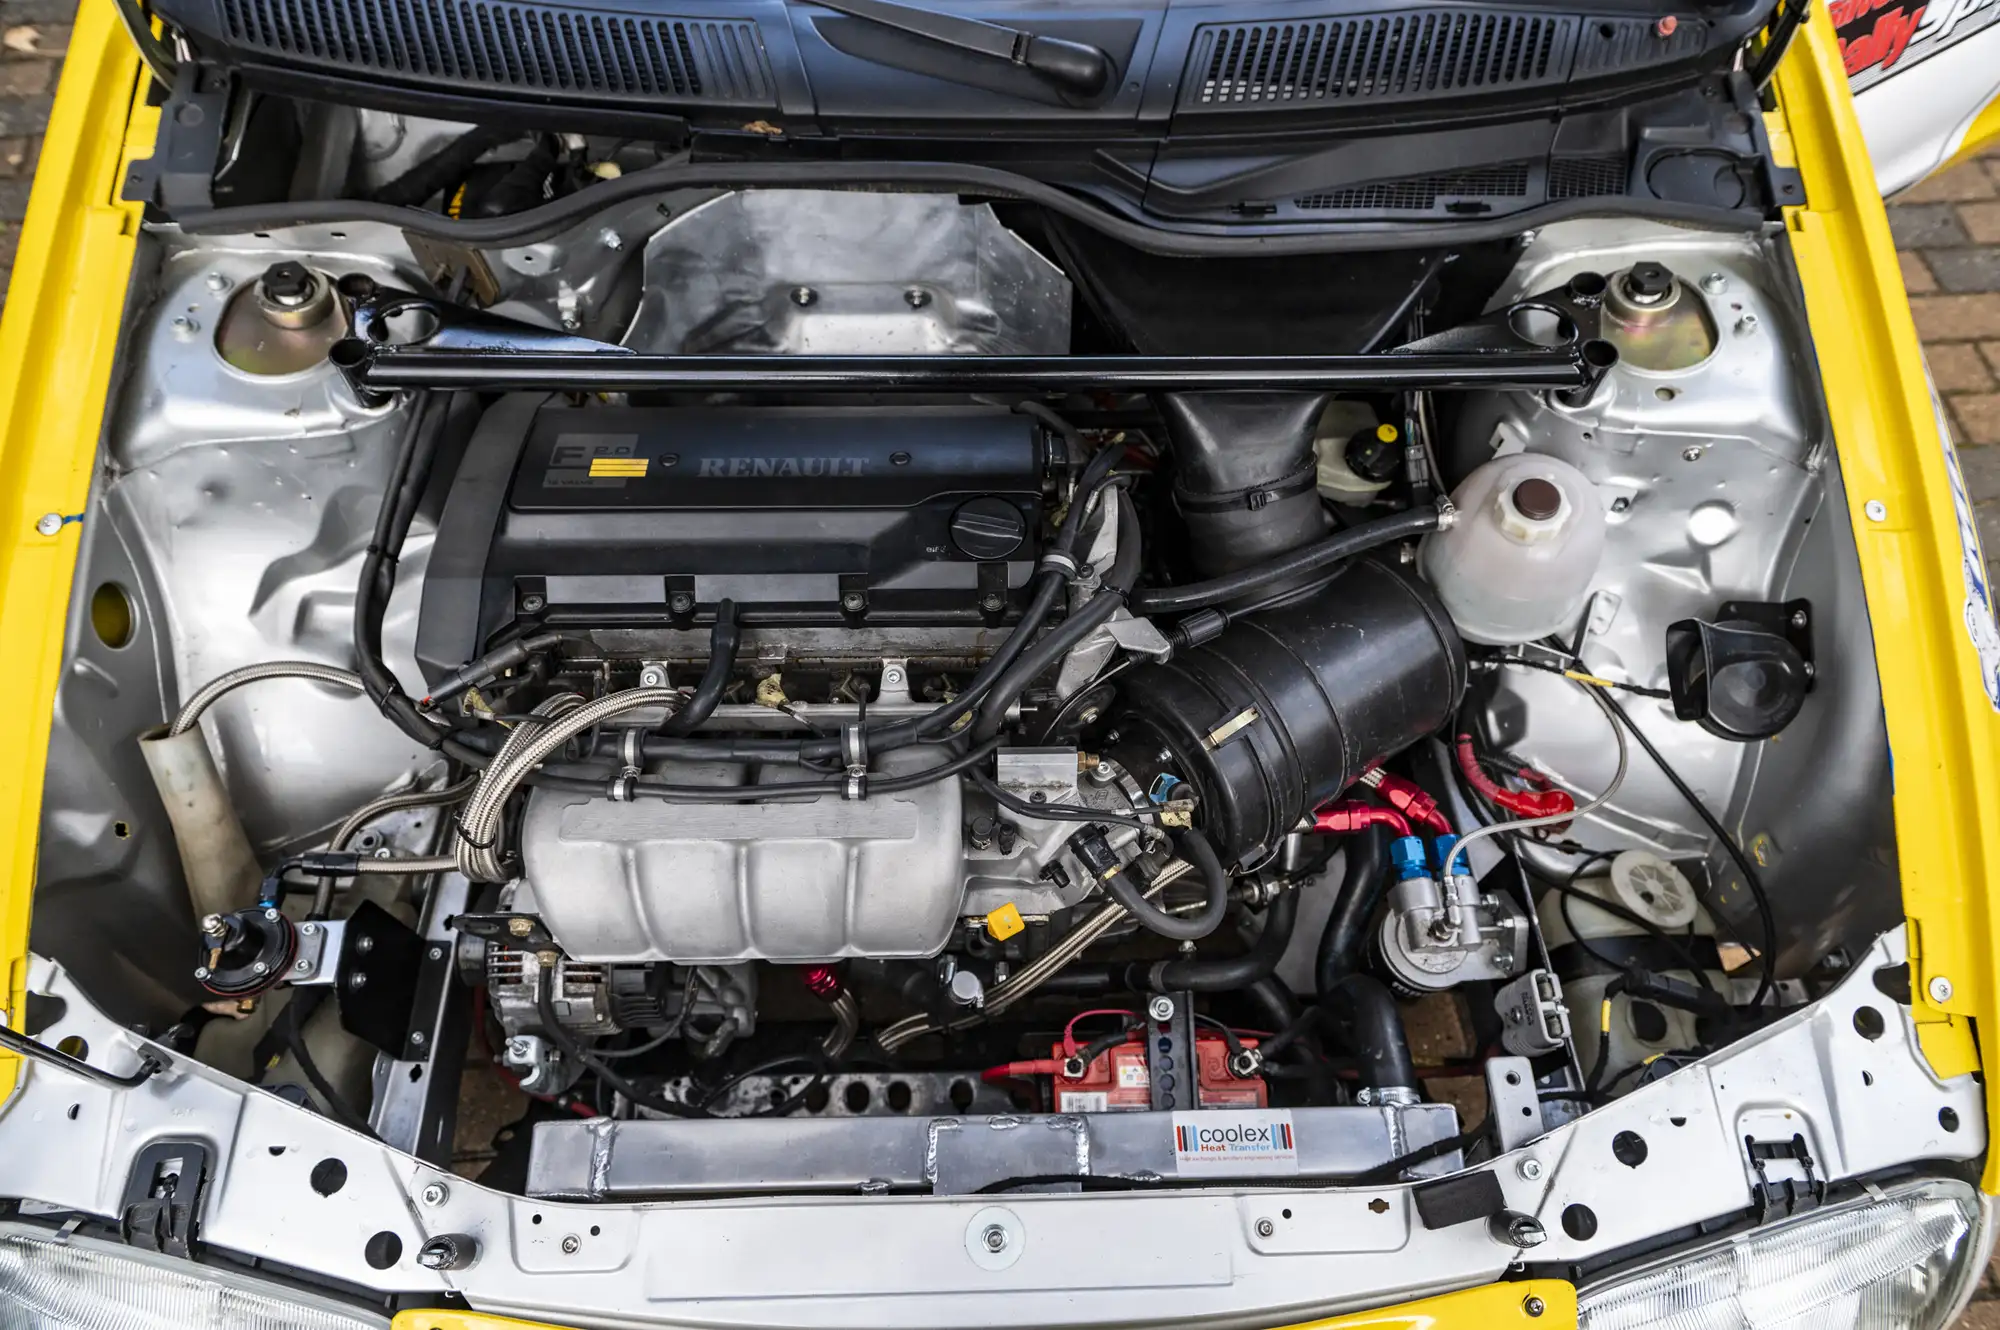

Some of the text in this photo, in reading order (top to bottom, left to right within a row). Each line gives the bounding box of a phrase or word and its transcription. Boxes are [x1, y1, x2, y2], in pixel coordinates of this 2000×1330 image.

[697, 457, 870, 477] RENAULT
[1200, 1124, 1270, 1143] coolex
[1200, 1143, 1271, 1152] Heat Transfer
